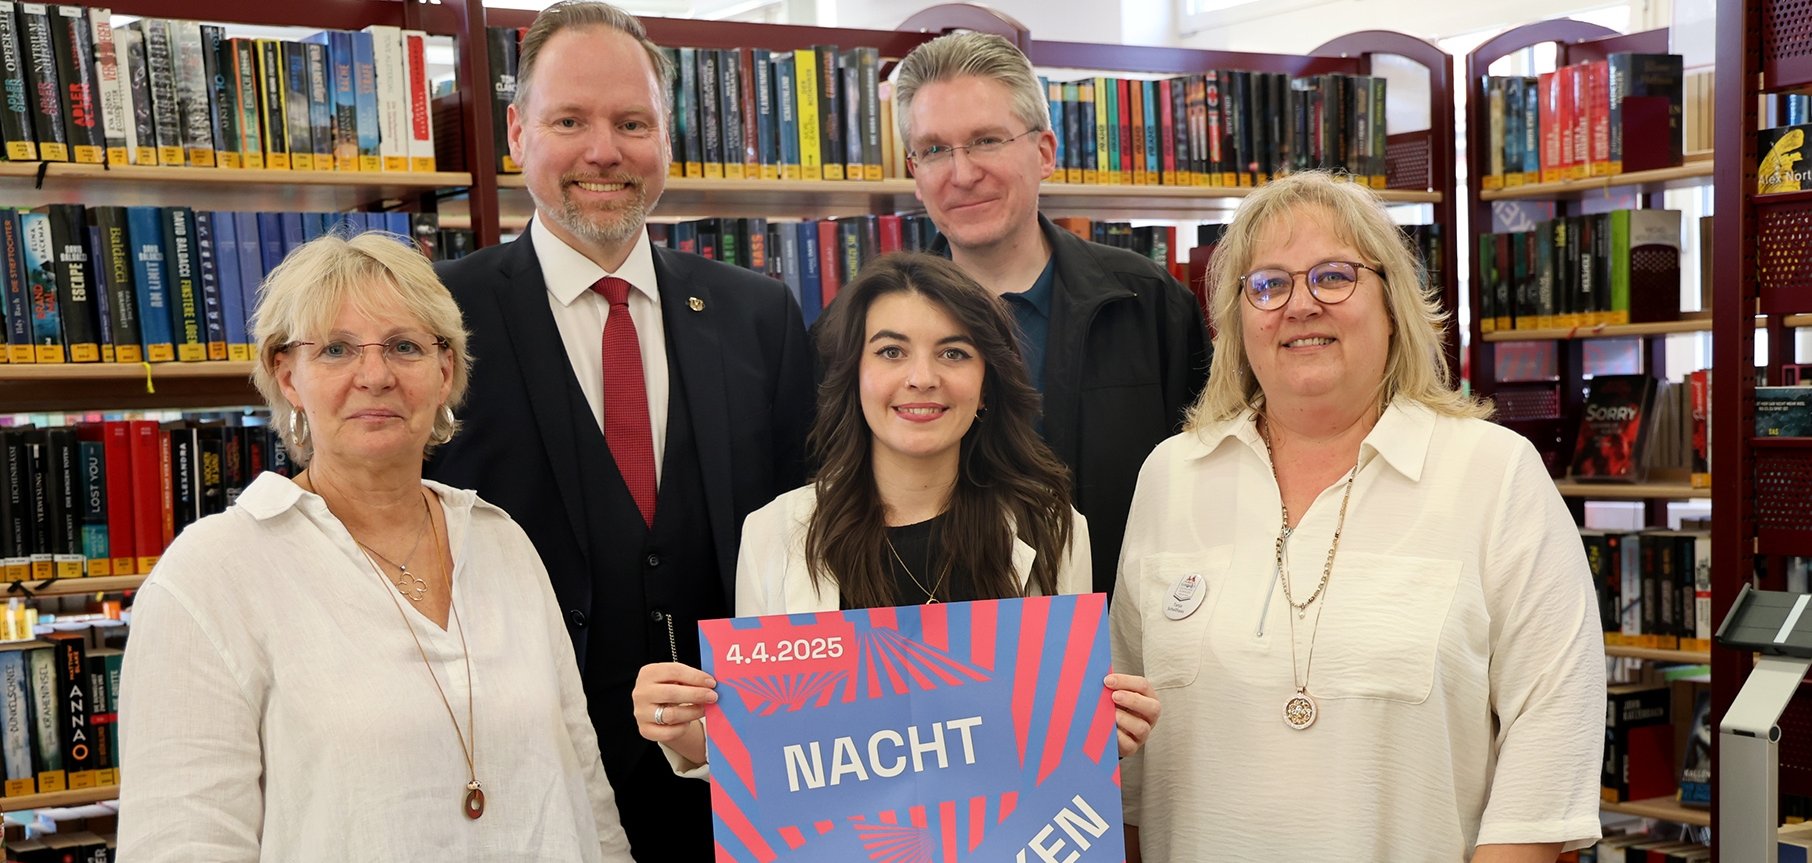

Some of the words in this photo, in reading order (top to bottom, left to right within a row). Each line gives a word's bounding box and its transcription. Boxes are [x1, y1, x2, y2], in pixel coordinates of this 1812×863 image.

[2, 32, 16, 72] OPFER
[28, 22, 43, 73] NATRIUM
[4, 78, 18, 111] ADLER
[37, 81, 49, 114] ADLER
[68, 82, 84, 127] ADLER
[758, 60, 770, 115] FLAMMENMEER
[1760, 173, 1781, 184] Alex
[30, 226, 38, 252] ELINA
[36, 219, 47, 259] BACKMAN
[173, 211, 185, 236] DAVID
[4, 219, 17, 279] STIEFTOCHTER
[109, 226, 128, 284] Baldacci
[176, 237, 191, 278] BALDACCI
[751, 234, 765, 267] HASS
[9, 278, 19, 293] DIE
[69, 262, 87, 302] ESCAPE
[146, 261, 162, 291] LIMIT
[11, 297, 21, 316] Bach
[32, 283, 46, 319] BRAND
[44, 289, 55, 312] MAL
[180, 279, 196, 318] FINSTERE
[1585, 404, 1638, 421] SORRY
[88, 457, 99, 478] YOU
[180, 442, 188, 502] ALEXANDRA
[35, 472, 44, 523] VERWESUNG
[88, 483, 100, 513] LOST
[67, 644, 75, 681] MATTHEW
[726, 636, 844, 665] 4.4.2025
[6, 664, 20, 734] DUNKELSCHNEE
[69, 684, 86, 743] ANNA
[1623, 699, 1640, 711] JOHN
[72, 744, 89, 761] O
[783, 716, 983, 792] NACHT
